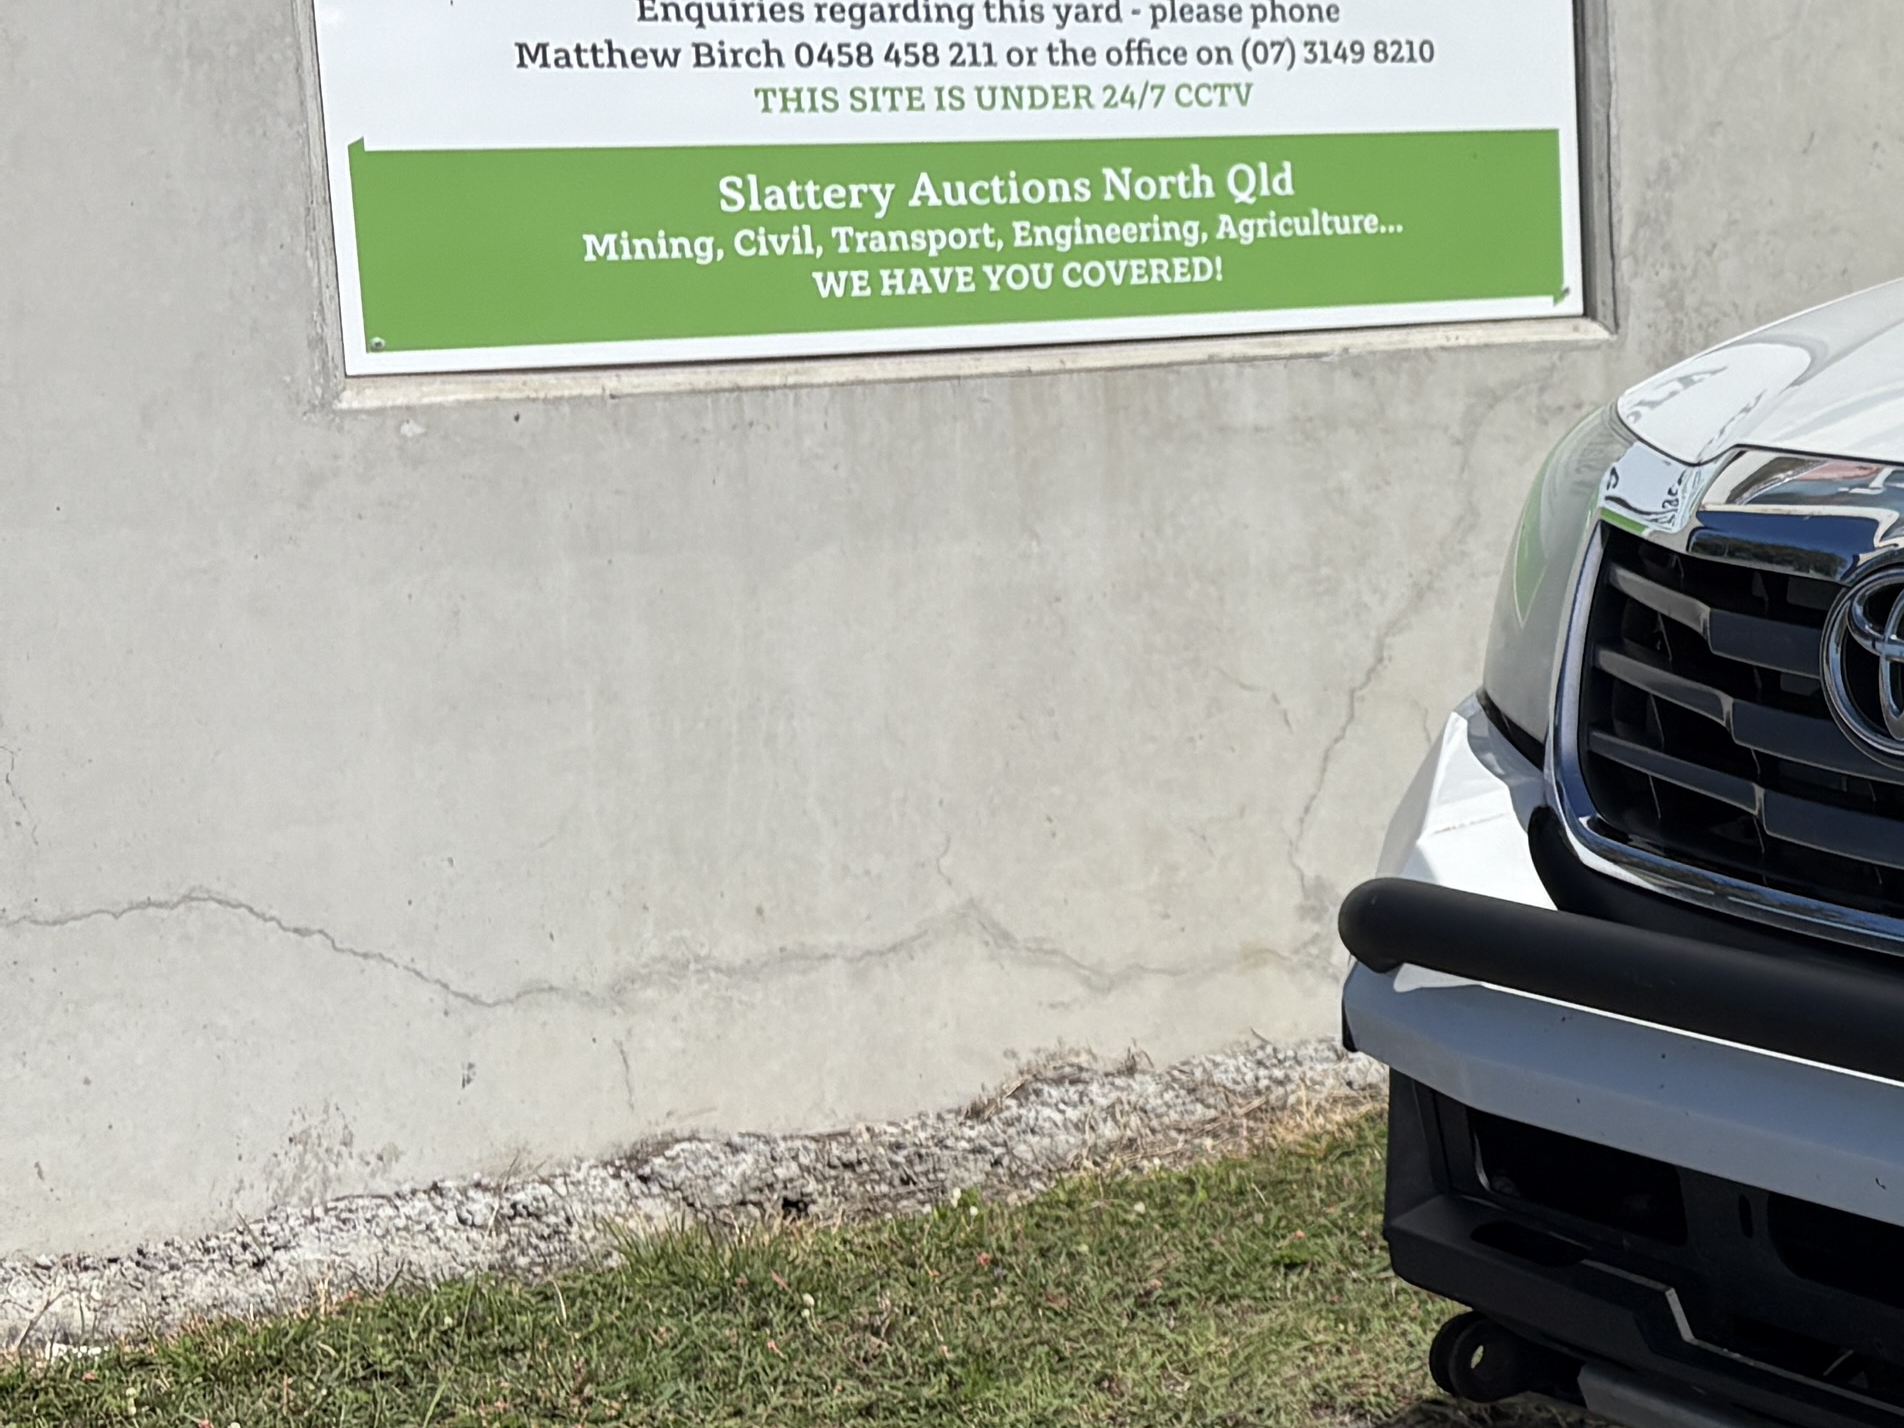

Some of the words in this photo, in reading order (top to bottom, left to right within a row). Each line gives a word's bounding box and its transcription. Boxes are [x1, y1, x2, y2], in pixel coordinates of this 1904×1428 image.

[514, 39, 682, 69] Matthew
[691, 39, 784, 69] Birch
[794, 42, 873, 68] 0458
[883, 42, 940, 67] 458
[949, 42, 994, 67] 211
[1006, 45, 1038, 67] or
[1046, 39, 1096, 67] the
[1105, 38, 1187, 66] office
[1196, 45, 1233, 66] on
[1241, 37, 1296, 71] (07)
[1303, 40, 1365, 65] 3149
[1373, 39, 1435, 64] 8210
[754, 86, 839, 114] THIS
[849, 86, 925, 113] SITE
[935, 86, 965, 111] IS
[974, 84, 1095, 111] UNDER
[1102, 80, 1164, 111] 24/7
[1174, 83, 1253, 108] CCTV
[718, 173, 895, 219] Slattery
[908, 170, 1091, 207] Auctions
[1101, 164, 1215, 202] North
[1226, 161, 1295, 204] Qld
[582, 230, 724, 265] Mining,
[734, 224, 824, 259] Civil,
[831, 222, 1004, 257] Transport,
[1012, 215, 1208, 252] Engineering,
[1215, 208, 1404, 245] Agriculture...
[812, 270, 871, 298] WE
[880, 266, 975, 296] HAVE
[982, 263, 1053, 292] YOU
[1062, 256, 1224, 287] COVERED!
